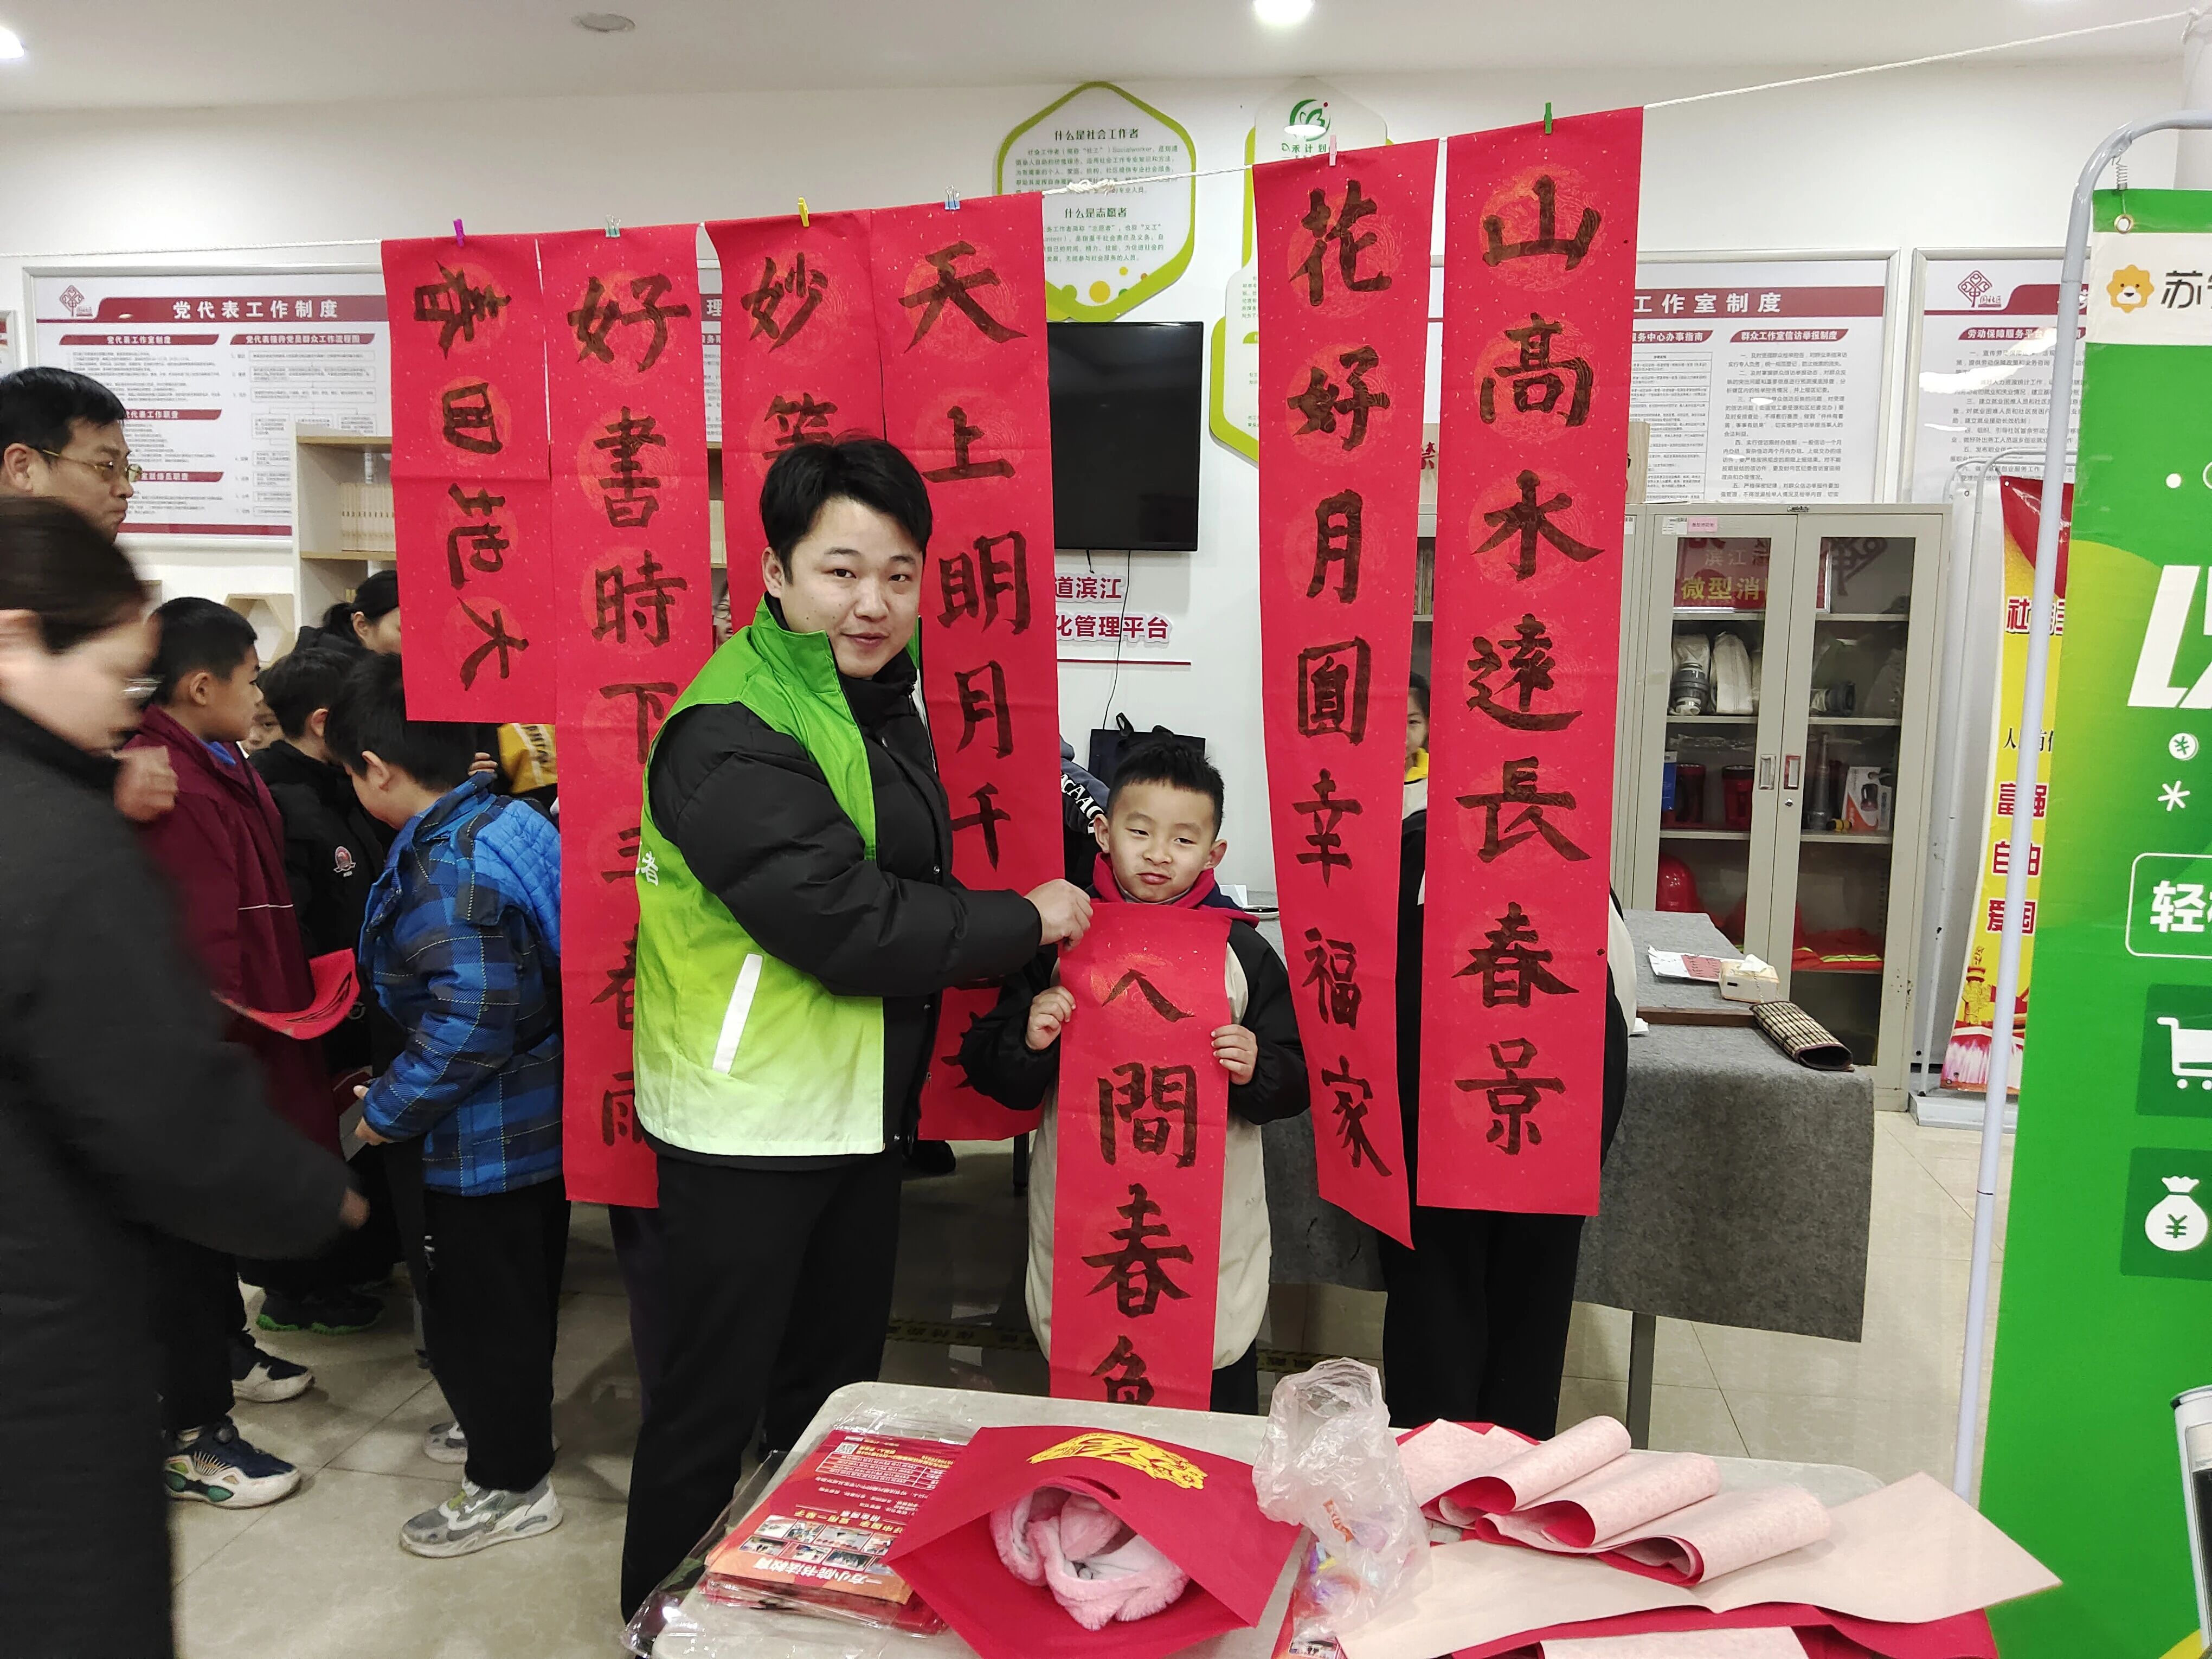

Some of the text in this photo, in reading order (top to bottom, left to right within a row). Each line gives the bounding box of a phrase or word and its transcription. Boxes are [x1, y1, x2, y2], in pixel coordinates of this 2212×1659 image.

[1055, 128, 1139, 141] 什么是社会工作者
[1064, 208, 1128, 218] 什么是志愿者
[2161, 269, 2212, 309] 苏
[173, 300, 338, 319] 党代表工作制度
[1633, 292, 1782, 314] 工作室制度
[1741, 331, 1837, 341] 群众工作室信访举报制度
[1055, 576, 1122, 599] 道滨江
[1681, 576, 1767, 600] 微型消
[1056, 614, 1168, 639] 化管理平台
[898, 240, 1029, 1090] 天上明月千
[2150, 879, 2212, 933] 轻
[752, 1557, 883, 1585] 一方小院书法教育
